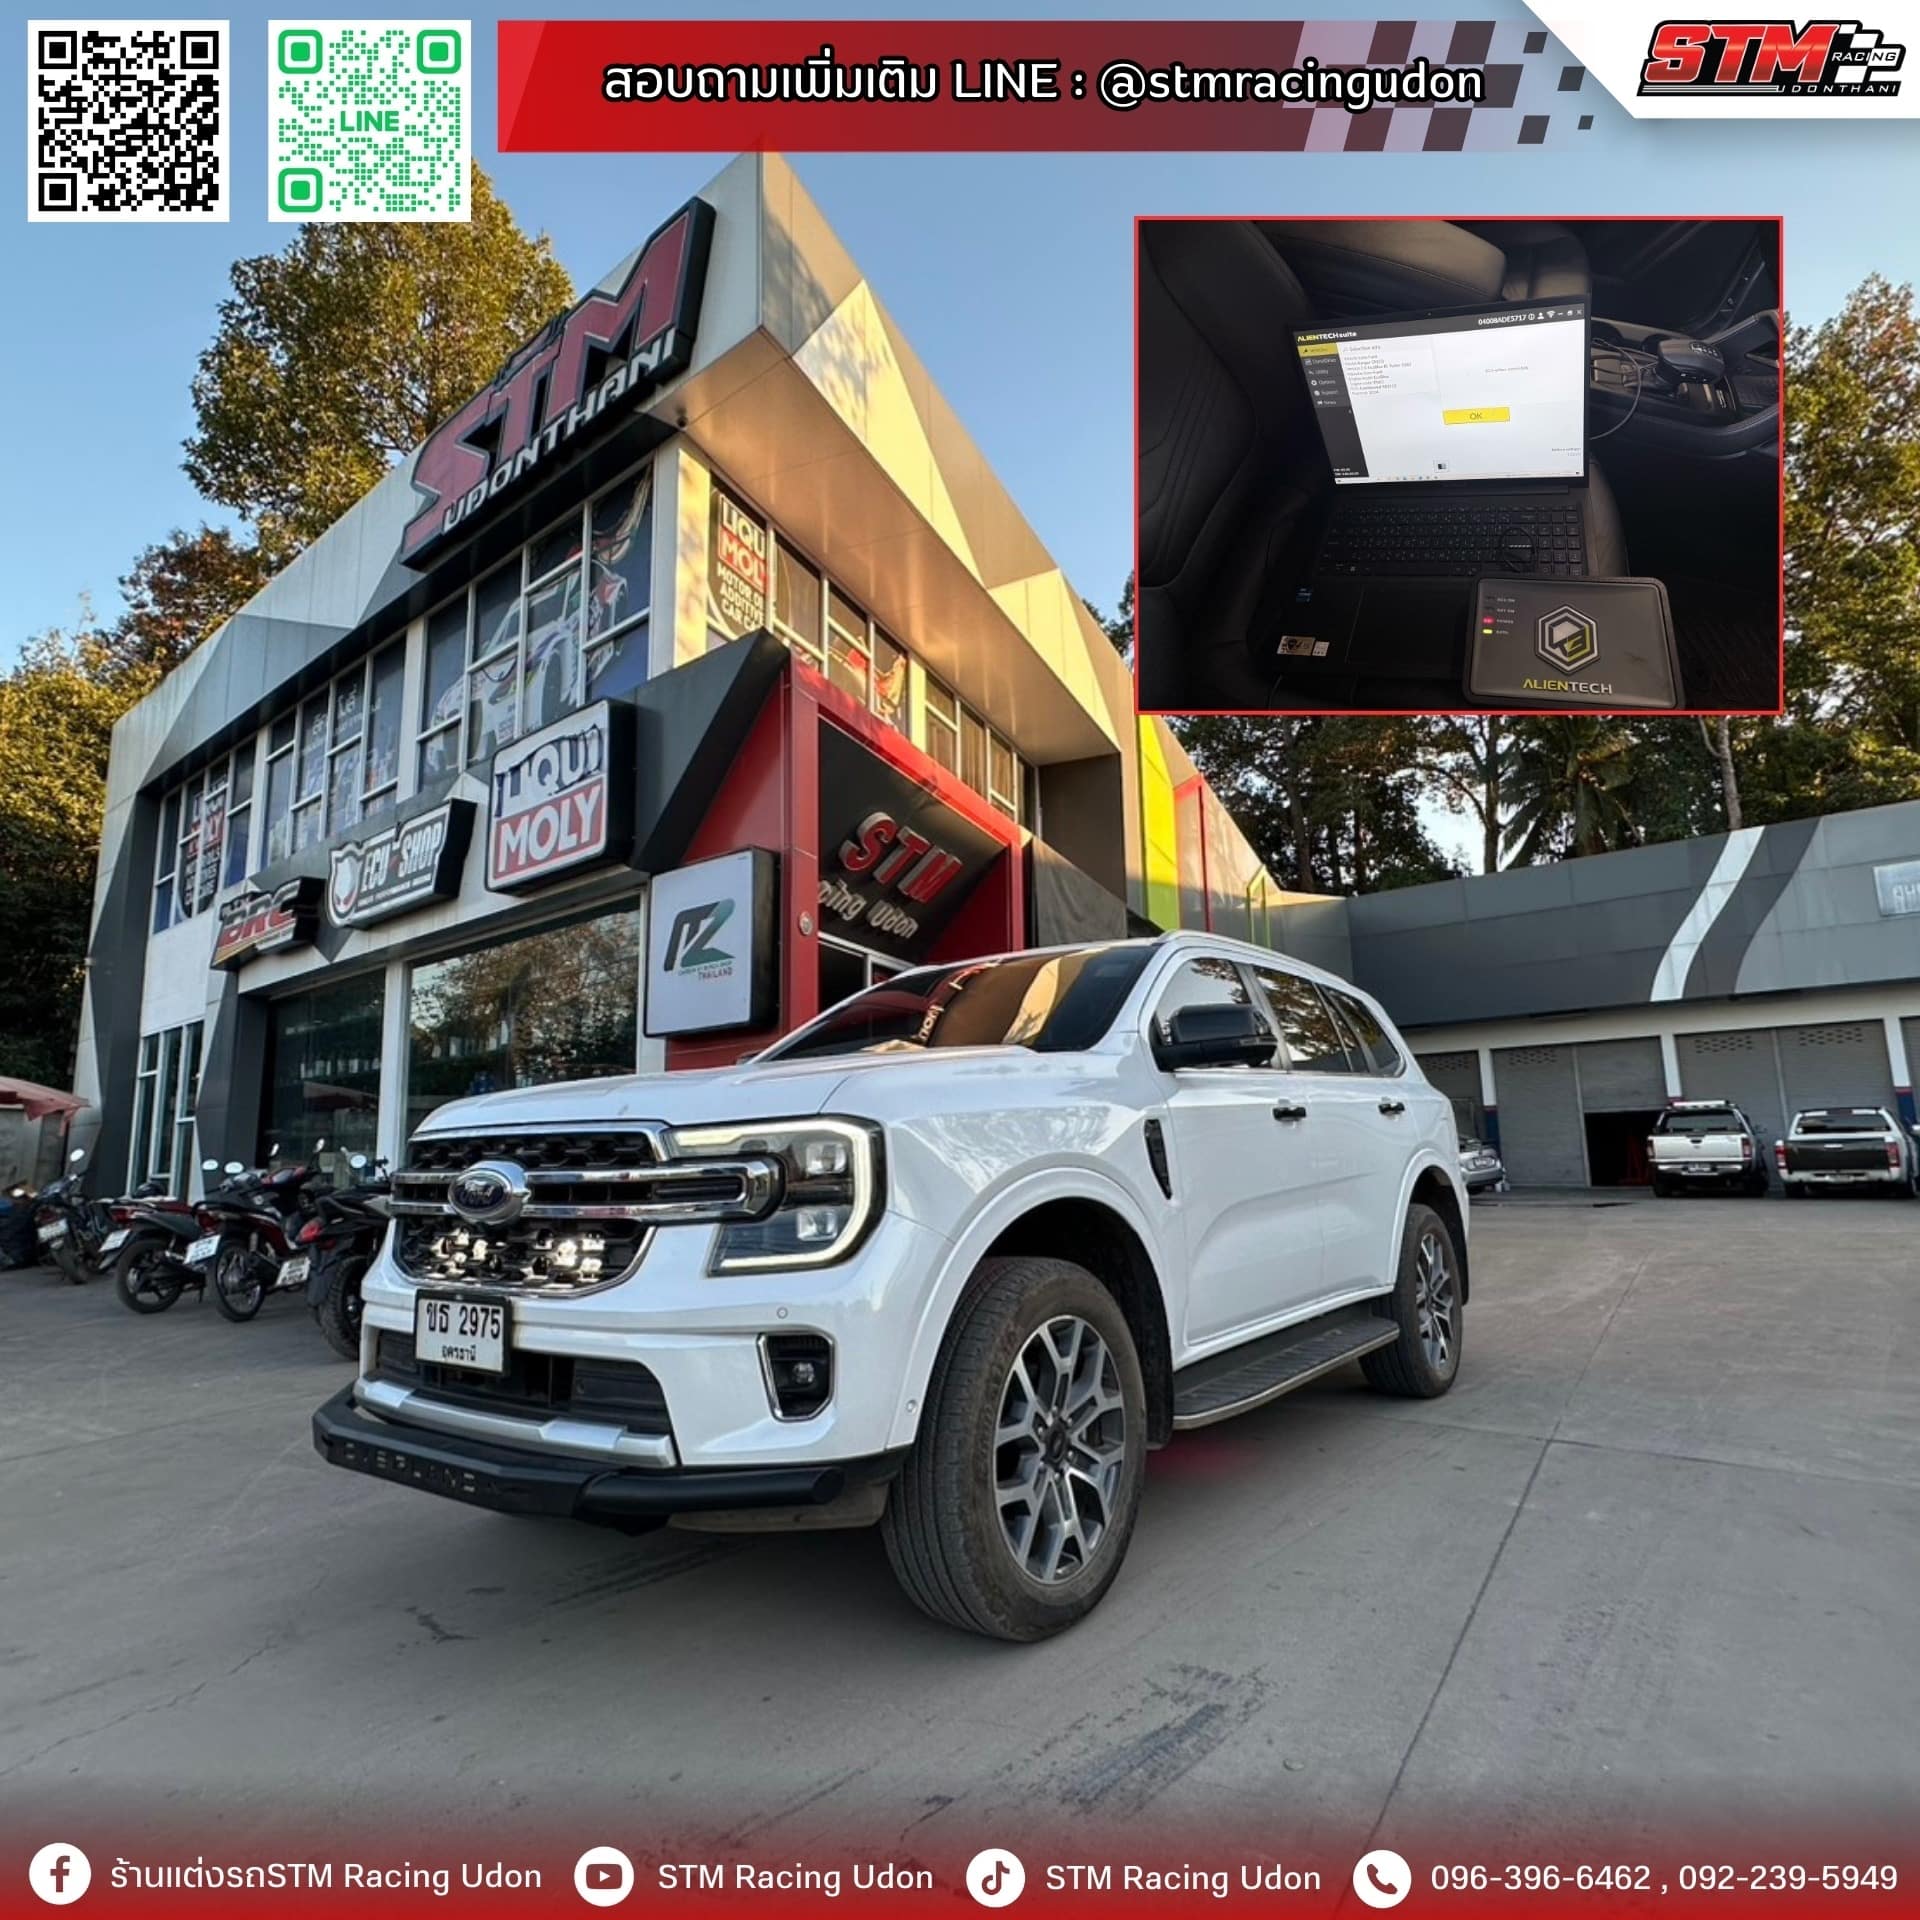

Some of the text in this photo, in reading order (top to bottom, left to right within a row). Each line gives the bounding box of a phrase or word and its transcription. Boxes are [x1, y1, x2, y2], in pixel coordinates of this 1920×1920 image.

[1297, 333, 1339, 342] ALIENTECH
[402, 211, 690, 552] STM
[443, 330, 676, 532] UDONTHANI
[1469, 410, 1483, 421] OK
[722, 500, 766, 561] LIQU
[717, 561, 753, 602] MOTOR
[720, 531, 768, 593] MOL
[720, 597, 743, 625] CAR
[1523, 678, 1613, 695] ALIENTECH
[361, 842, 391, 892] ECU
[397, 821, 443, 878] SHOP
[498, 783, 602, 873] MOLY
[839, 812, 963, 904] STM
[459, 1305, 501, 1340] 2975
